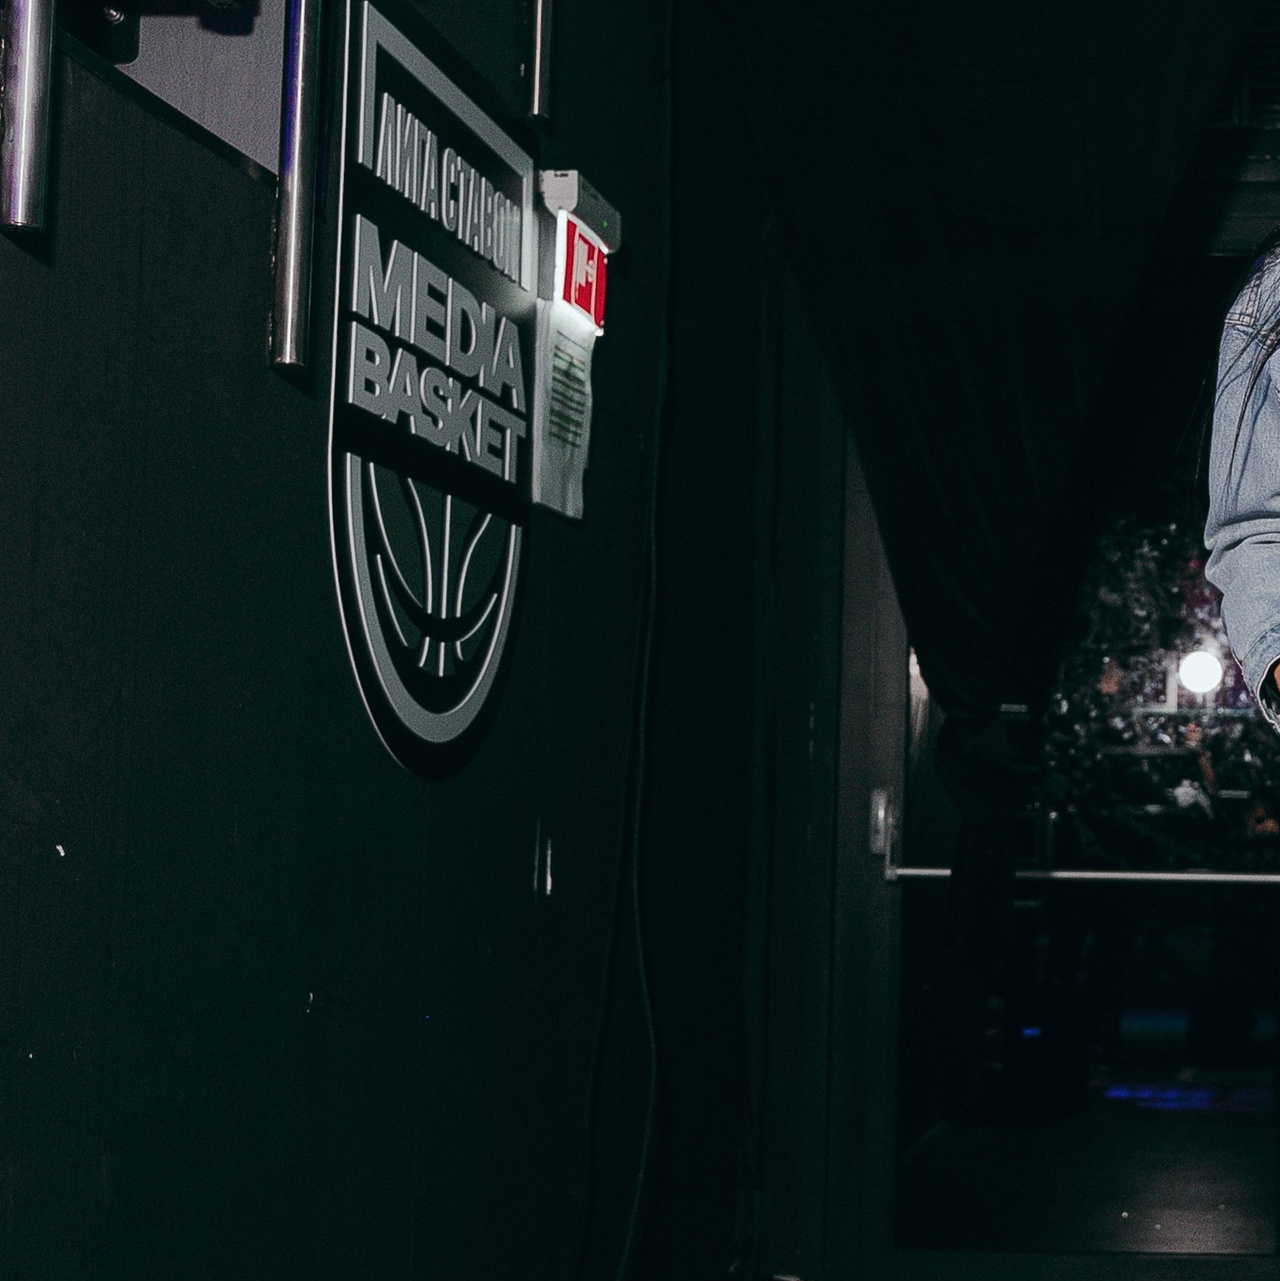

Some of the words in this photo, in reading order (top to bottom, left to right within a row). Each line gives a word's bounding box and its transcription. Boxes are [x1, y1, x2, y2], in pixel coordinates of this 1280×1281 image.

[376, 92, 439, 221] ЛИГА
[351, 213, 527, 415] MEDIA
[348, 320, 527, 484] BASKET
